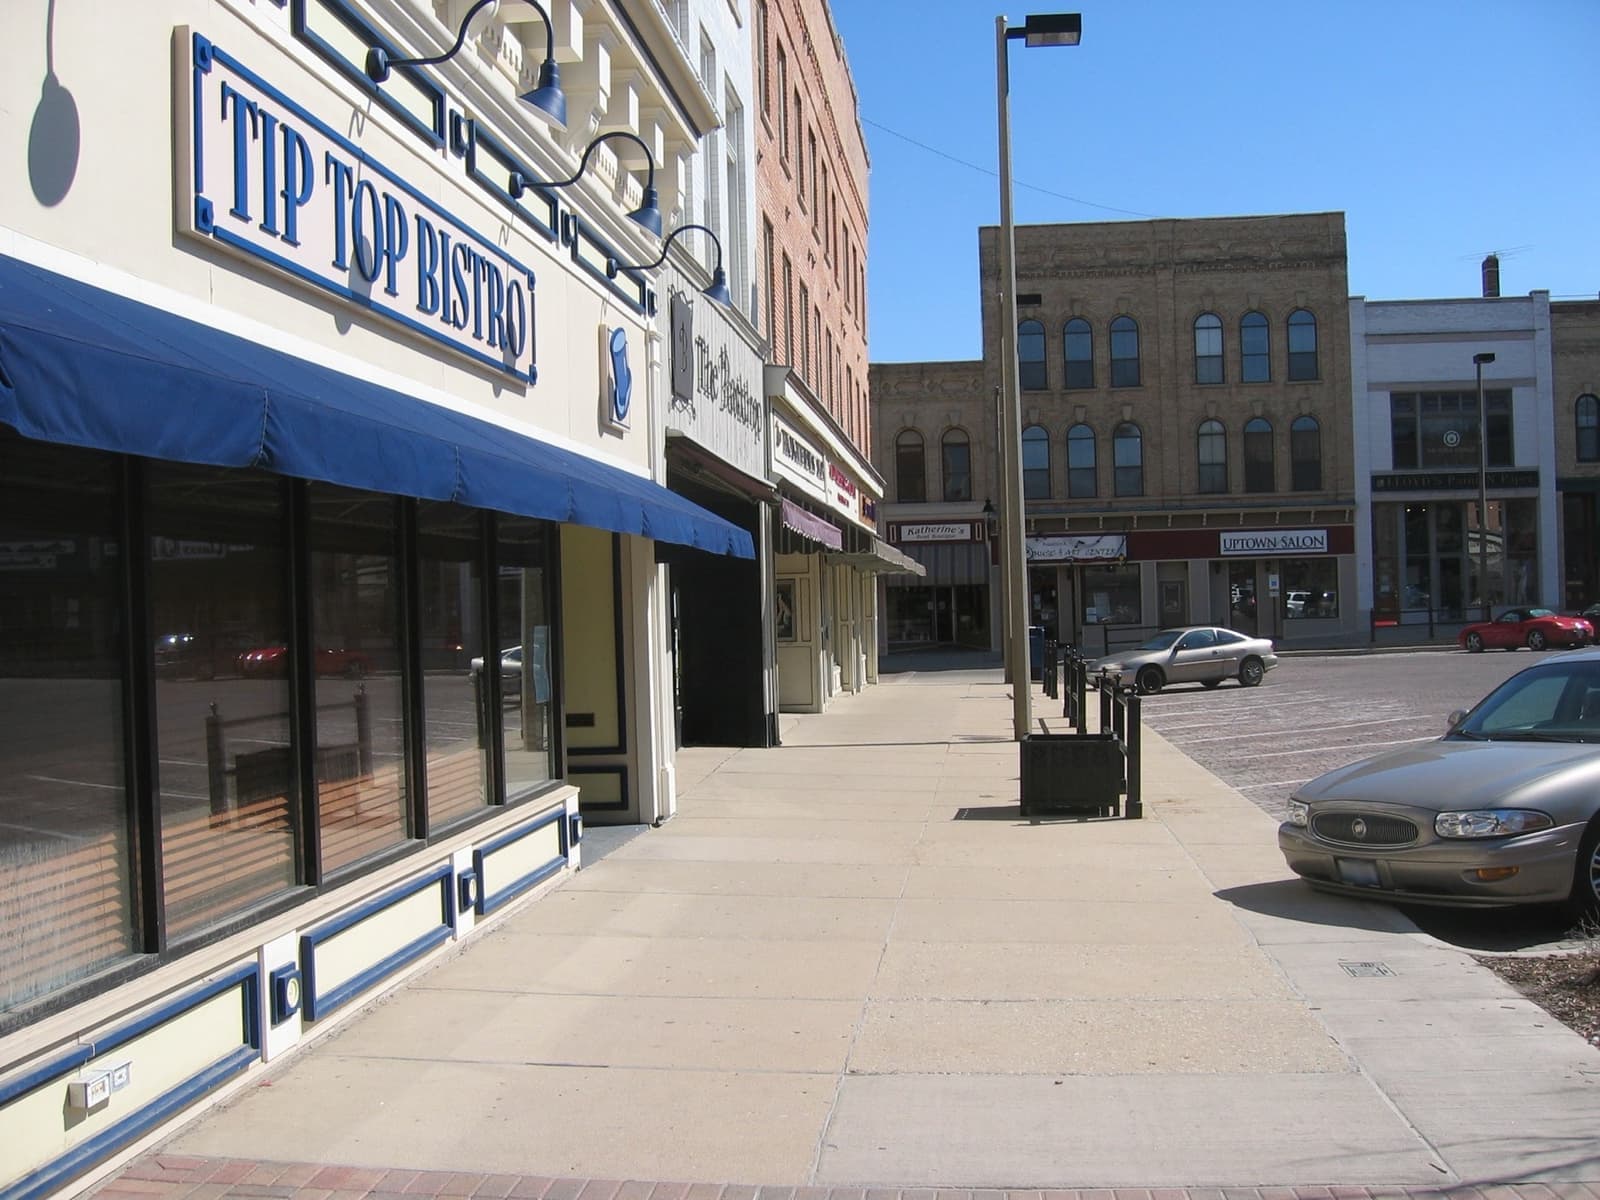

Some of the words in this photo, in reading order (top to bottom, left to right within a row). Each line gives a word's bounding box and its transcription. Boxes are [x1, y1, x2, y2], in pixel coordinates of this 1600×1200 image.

[220, 80, 315, 247] TIP
[325, 150, 409, 297] TOP
[414, 214, 527, 358] BISTRO
[695, 334, 719, 402] The
[907, 525, 964, 536] Katherine's
[1223, 536, 1277, 550] UPTOWN
[1280, 535, 1324, 549] SALON
